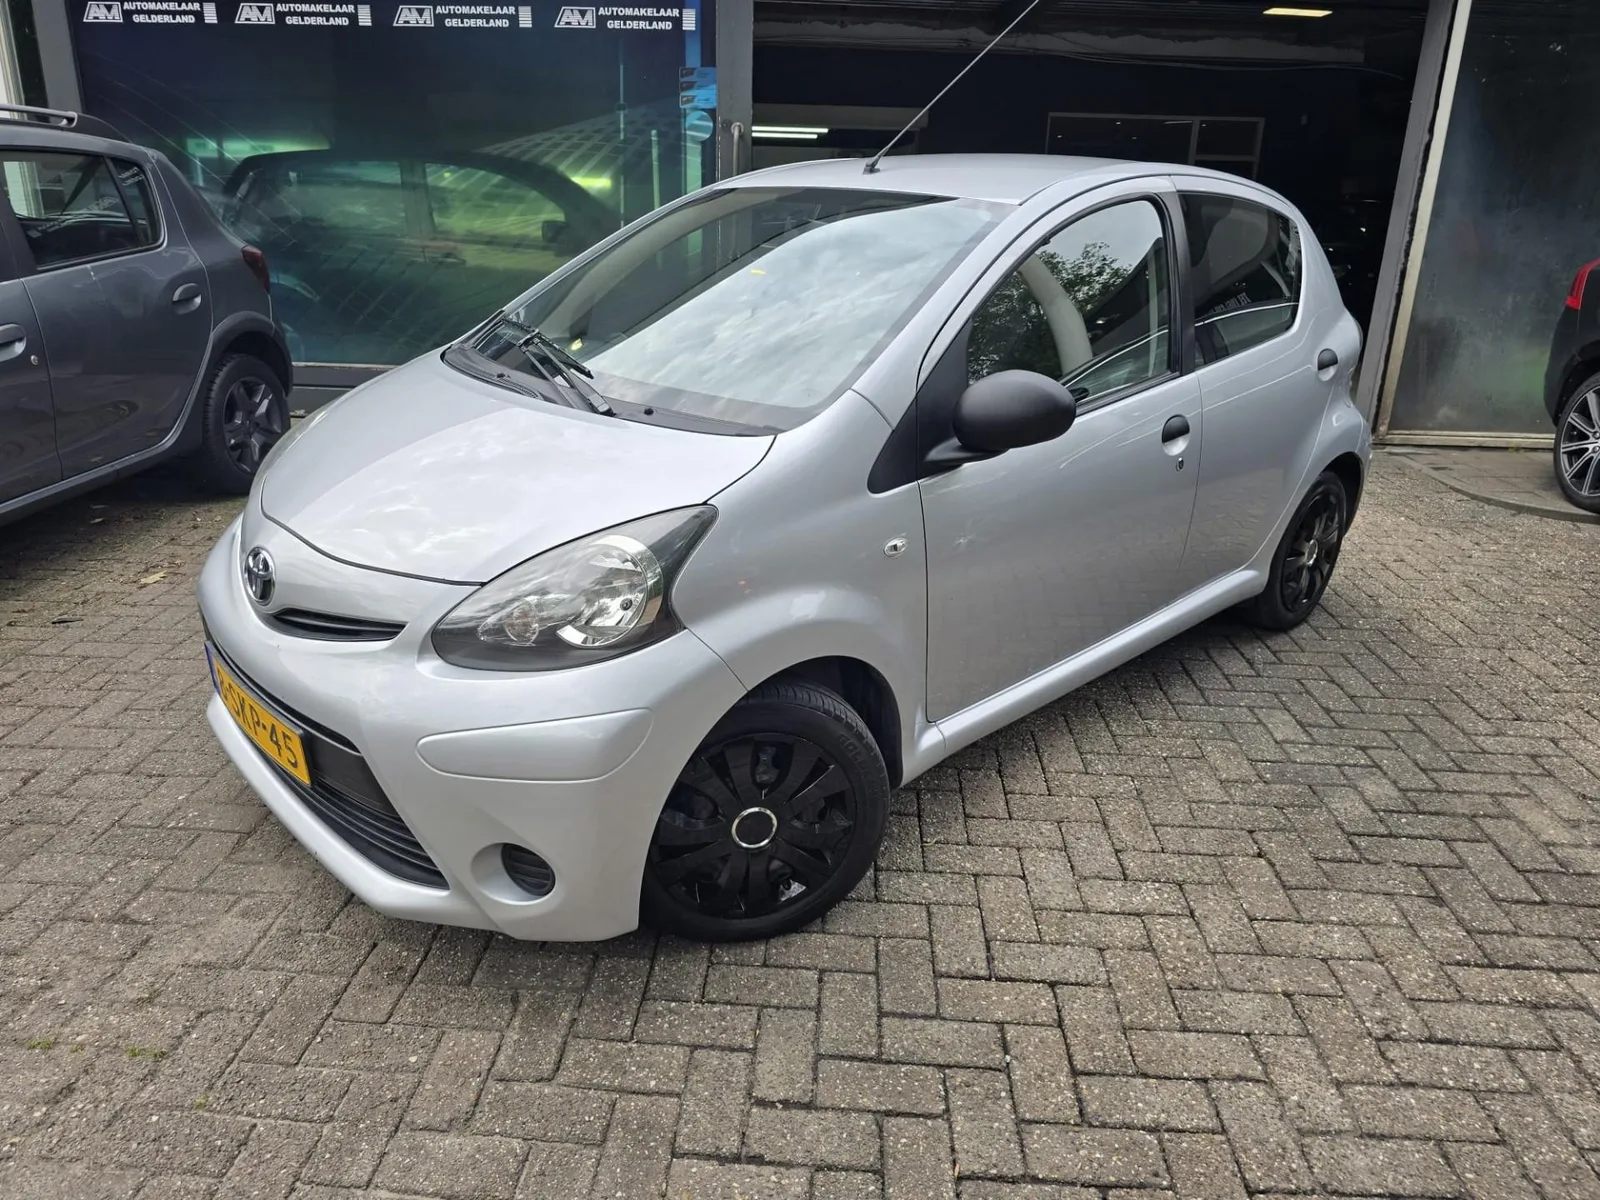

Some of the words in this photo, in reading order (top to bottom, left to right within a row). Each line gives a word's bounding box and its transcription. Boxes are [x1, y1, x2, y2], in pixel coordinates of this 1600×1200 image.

[123, 1, 200, 11] AUTOMAKELAAR
[275, 3, 355, 13] AUTOMAKELAAR
[435, 5, 516, 15] AUTOMAKELAAR
[87, 4, 120, 20] AM
[240, 6, 272, 22] AM
[399, 8, 431, 25] AM
[597, 6, 680, 17] AUTOMAKELAAR
[132, 14, 196, 24] GELDERLAND
[285, 15, 349, 26] GELDERLAND
[444, 18, 509, 28] GELDERLAND
[560, 10, 593, 26] AM
[606, 20, 672, 30] GELDERLAND
